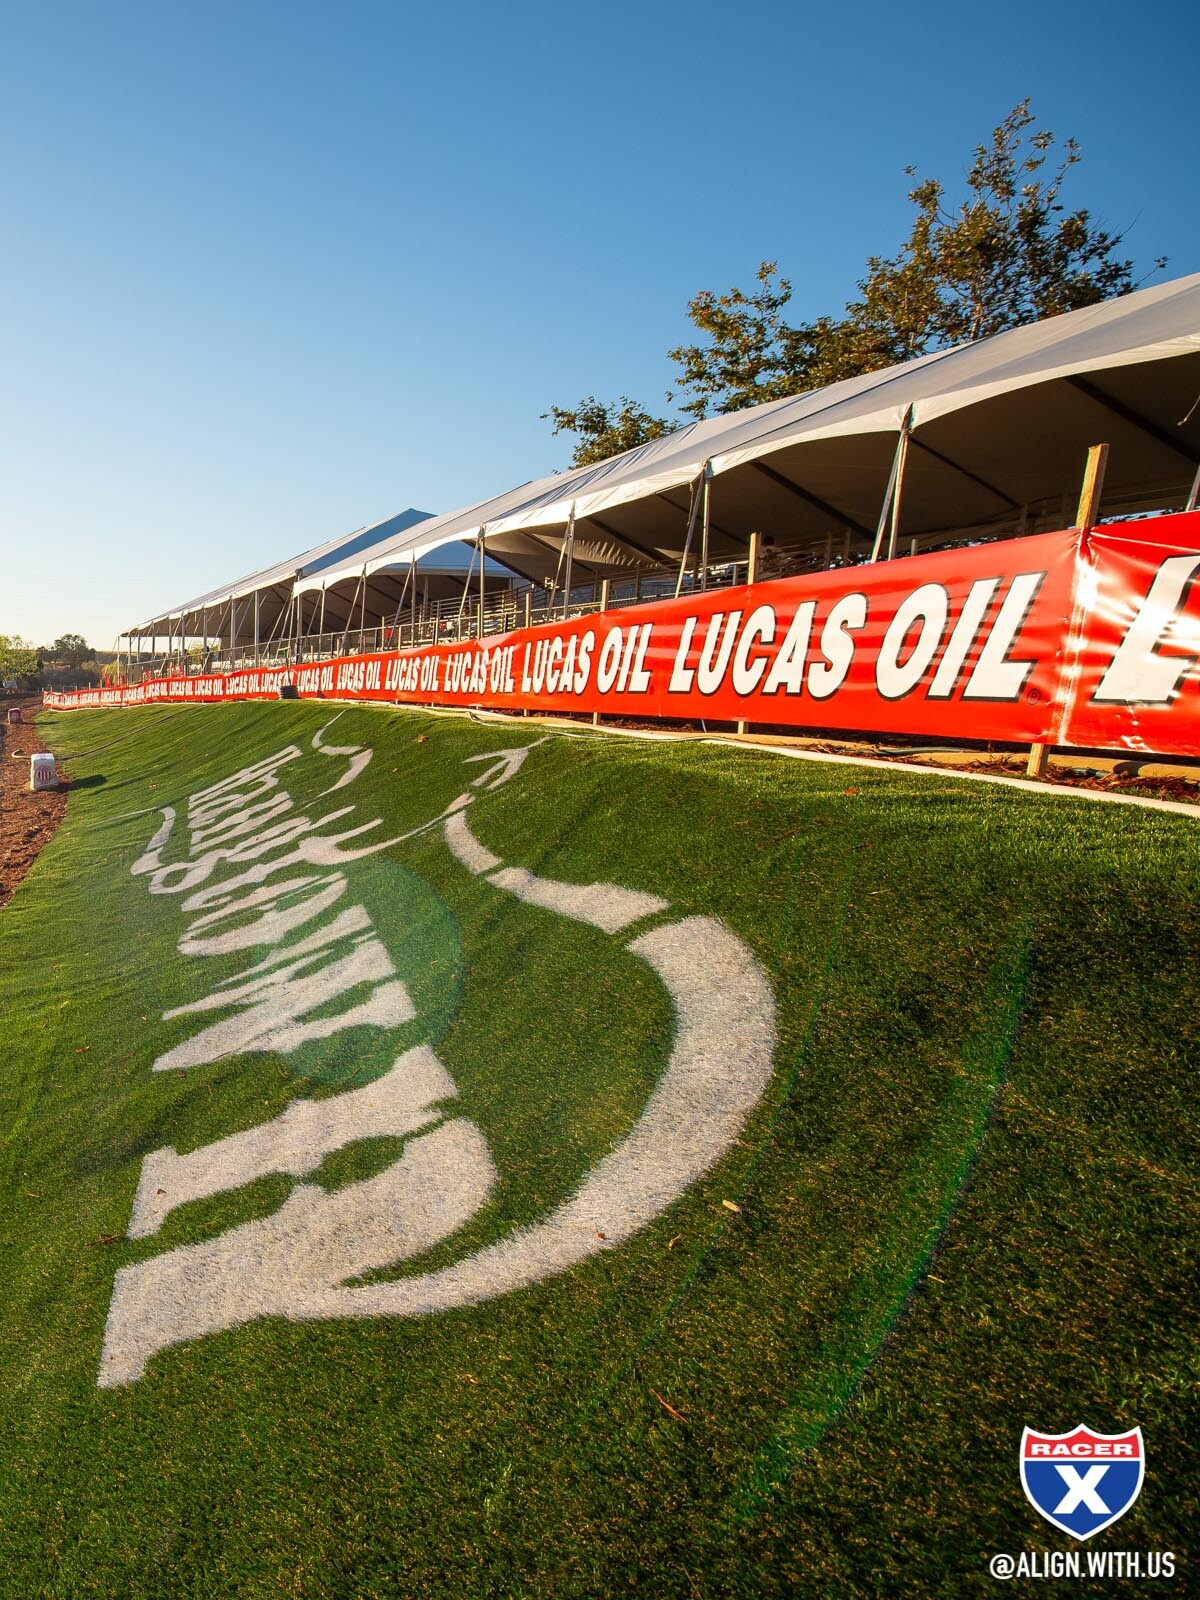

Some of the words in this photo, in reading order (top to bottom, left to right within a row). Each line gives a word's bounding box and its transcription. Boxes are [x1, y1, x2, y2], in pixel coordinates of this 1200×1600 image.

[668, 592, 871, 702] LUCAS
[875, 570, 1049, 703] OIL
[521, 630, 595, 695] LUCAS
[597, 623, 654, 694] OIL
[298, 668, 320, 692] LUCAS
[321, 666, 334, 691] OIL
[337, 661, 365, 691] LUCAS
[366, 659, 381, 691] OIL
[384, 657, 421, 692] LUCAS
[421, 656, 440, 692] OIL
[443, 649, 491, 693] LUCAS
[491, 646, 516, 694] OIL
[146, 682, 160, 698] LUCAS
[169, 681, 185, 696] LUCAS
[185, 681, 193, 696] OIL
[195, 679, 213, 696] LUCAS
[213, 679, 223, 695] OIL
[226, 675, 248, 695] LUCAS
[248, 674, 260, 692] OIL
[261, 672, 282, 692] LUCAS
[101, 690, 114, 702] LUCAS
[123, 688, 136, 701] LUCAS
